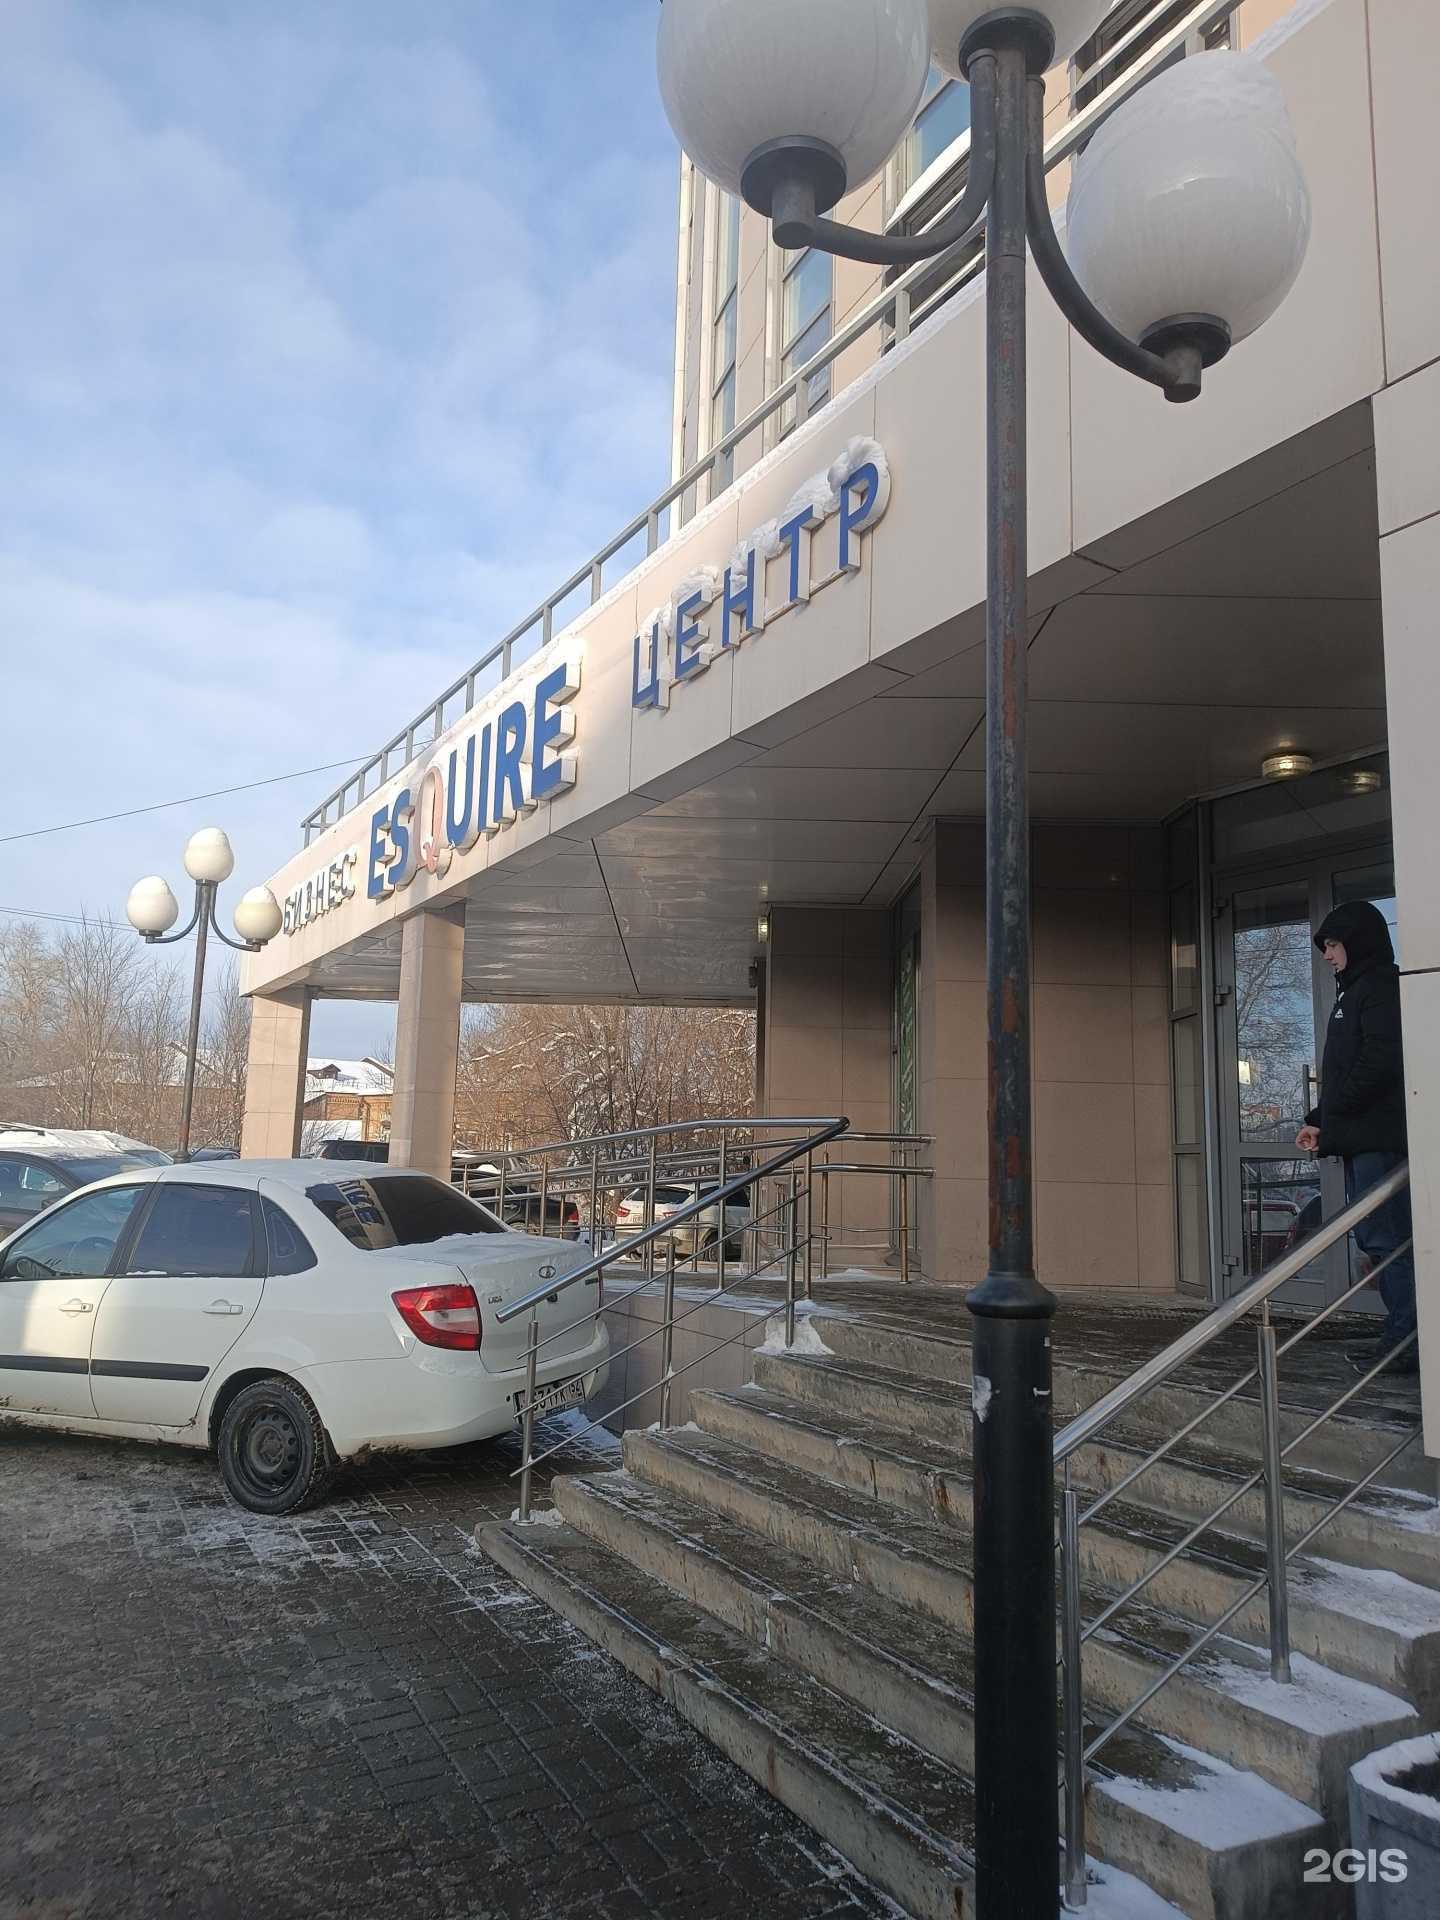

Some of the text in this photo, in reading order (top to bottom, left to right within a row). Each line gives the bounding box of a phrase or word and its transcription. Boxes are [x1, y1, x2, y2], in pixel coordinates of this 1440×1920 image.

[283, 461, 889, 936] БИЗНЕС ESQUIRE ЦЕНТР
